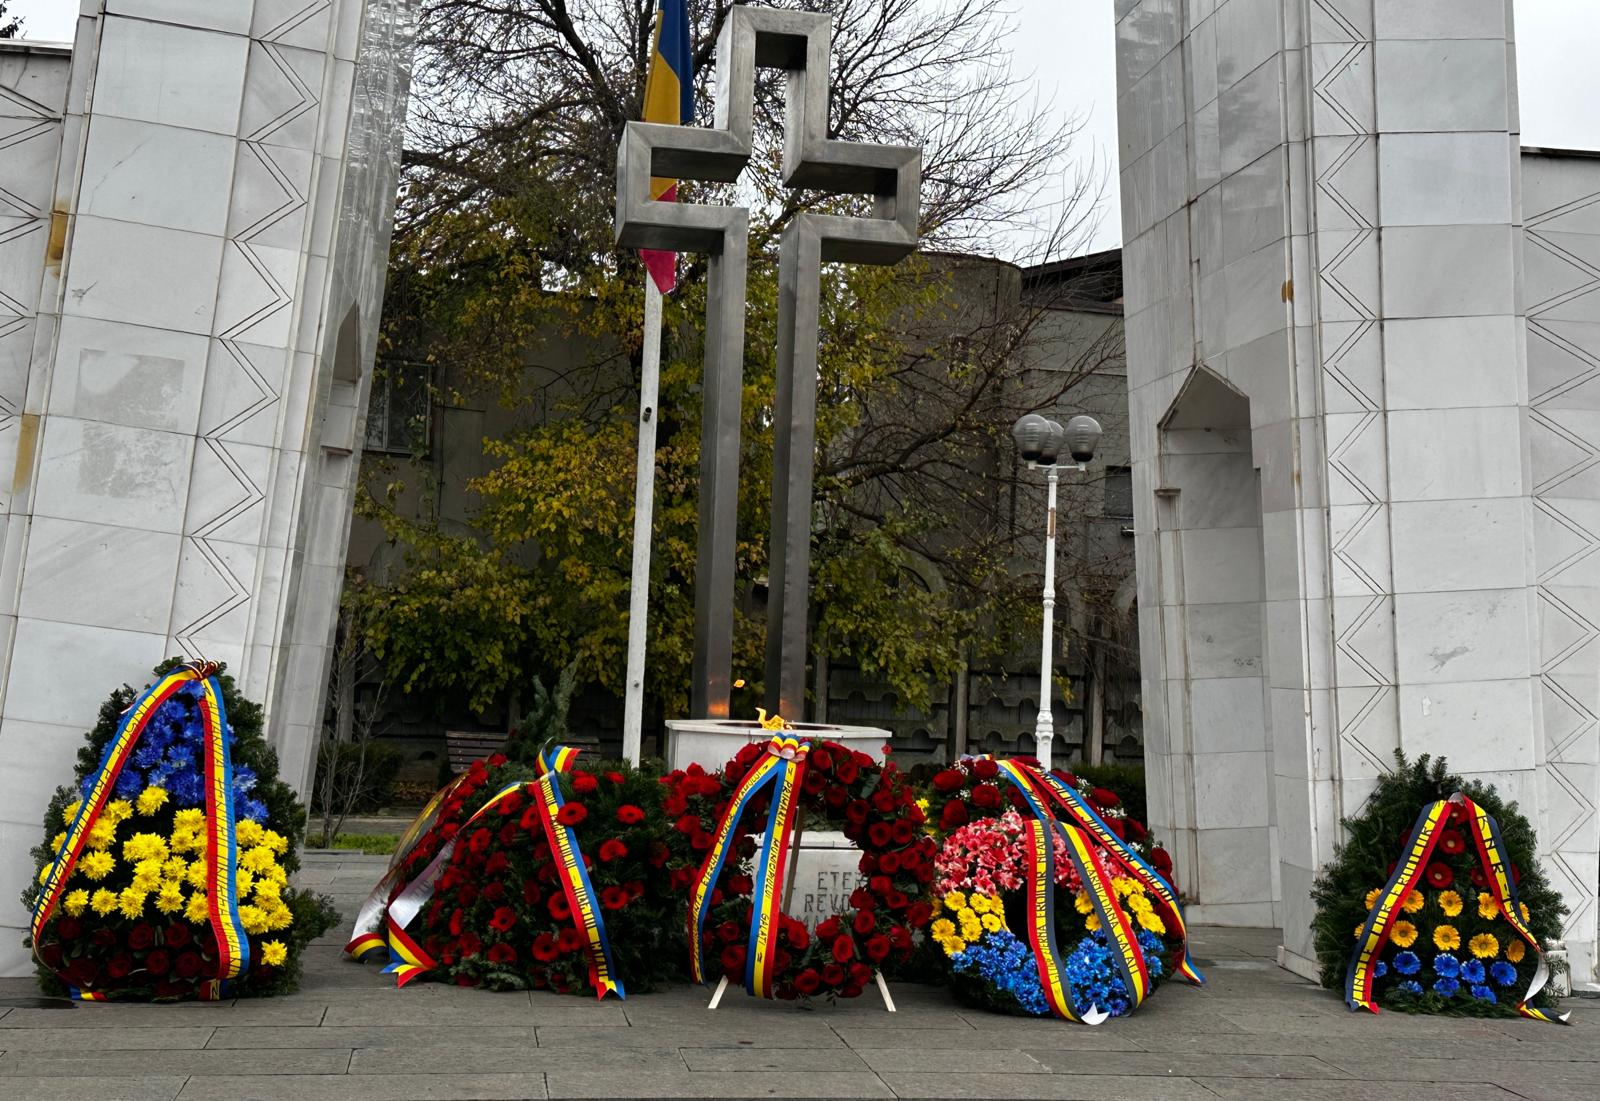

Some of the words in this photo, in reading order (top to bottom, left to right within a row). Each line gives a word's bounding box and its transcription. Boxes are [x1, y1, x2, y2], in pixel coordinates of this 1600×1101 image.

[763, 837, 782, 898] MUNICIPIULUI
[1035, 870, 1046, 918] EROILOR
[1081, 859, 1120, 928] GARNIZOANA
